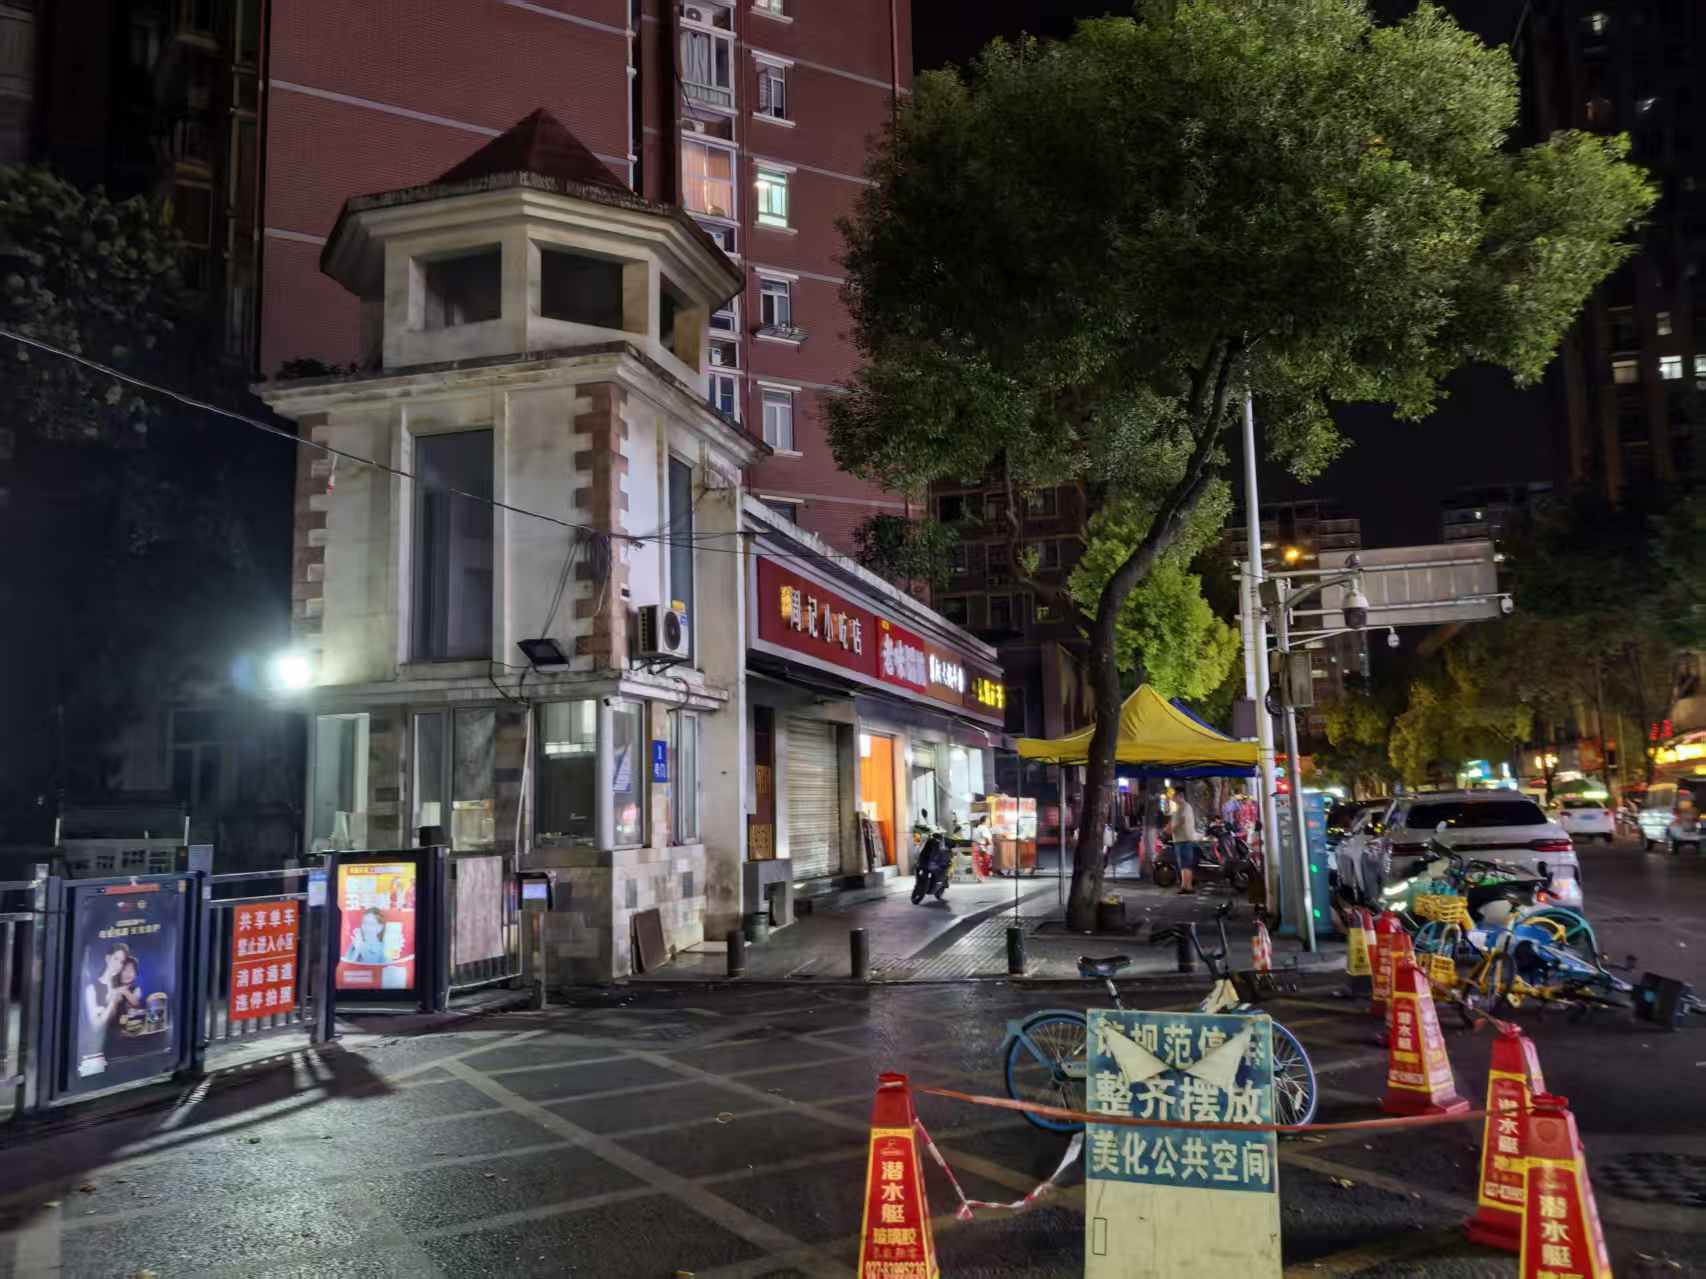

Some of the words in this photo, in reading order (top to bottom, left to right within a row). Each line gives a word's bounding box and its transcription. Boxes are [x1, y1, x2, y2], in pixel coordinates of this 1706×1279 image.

[238, 932, 294, 957] 禁止进入小区
[239, 908, 295, 931] 共享单车
[1096, 1070, 1264, 1125] 整齐摆放
[1092, 1129, 1270, 1185] 美化公共空间
[881, 1161, 905, 1223] 潜水艇
